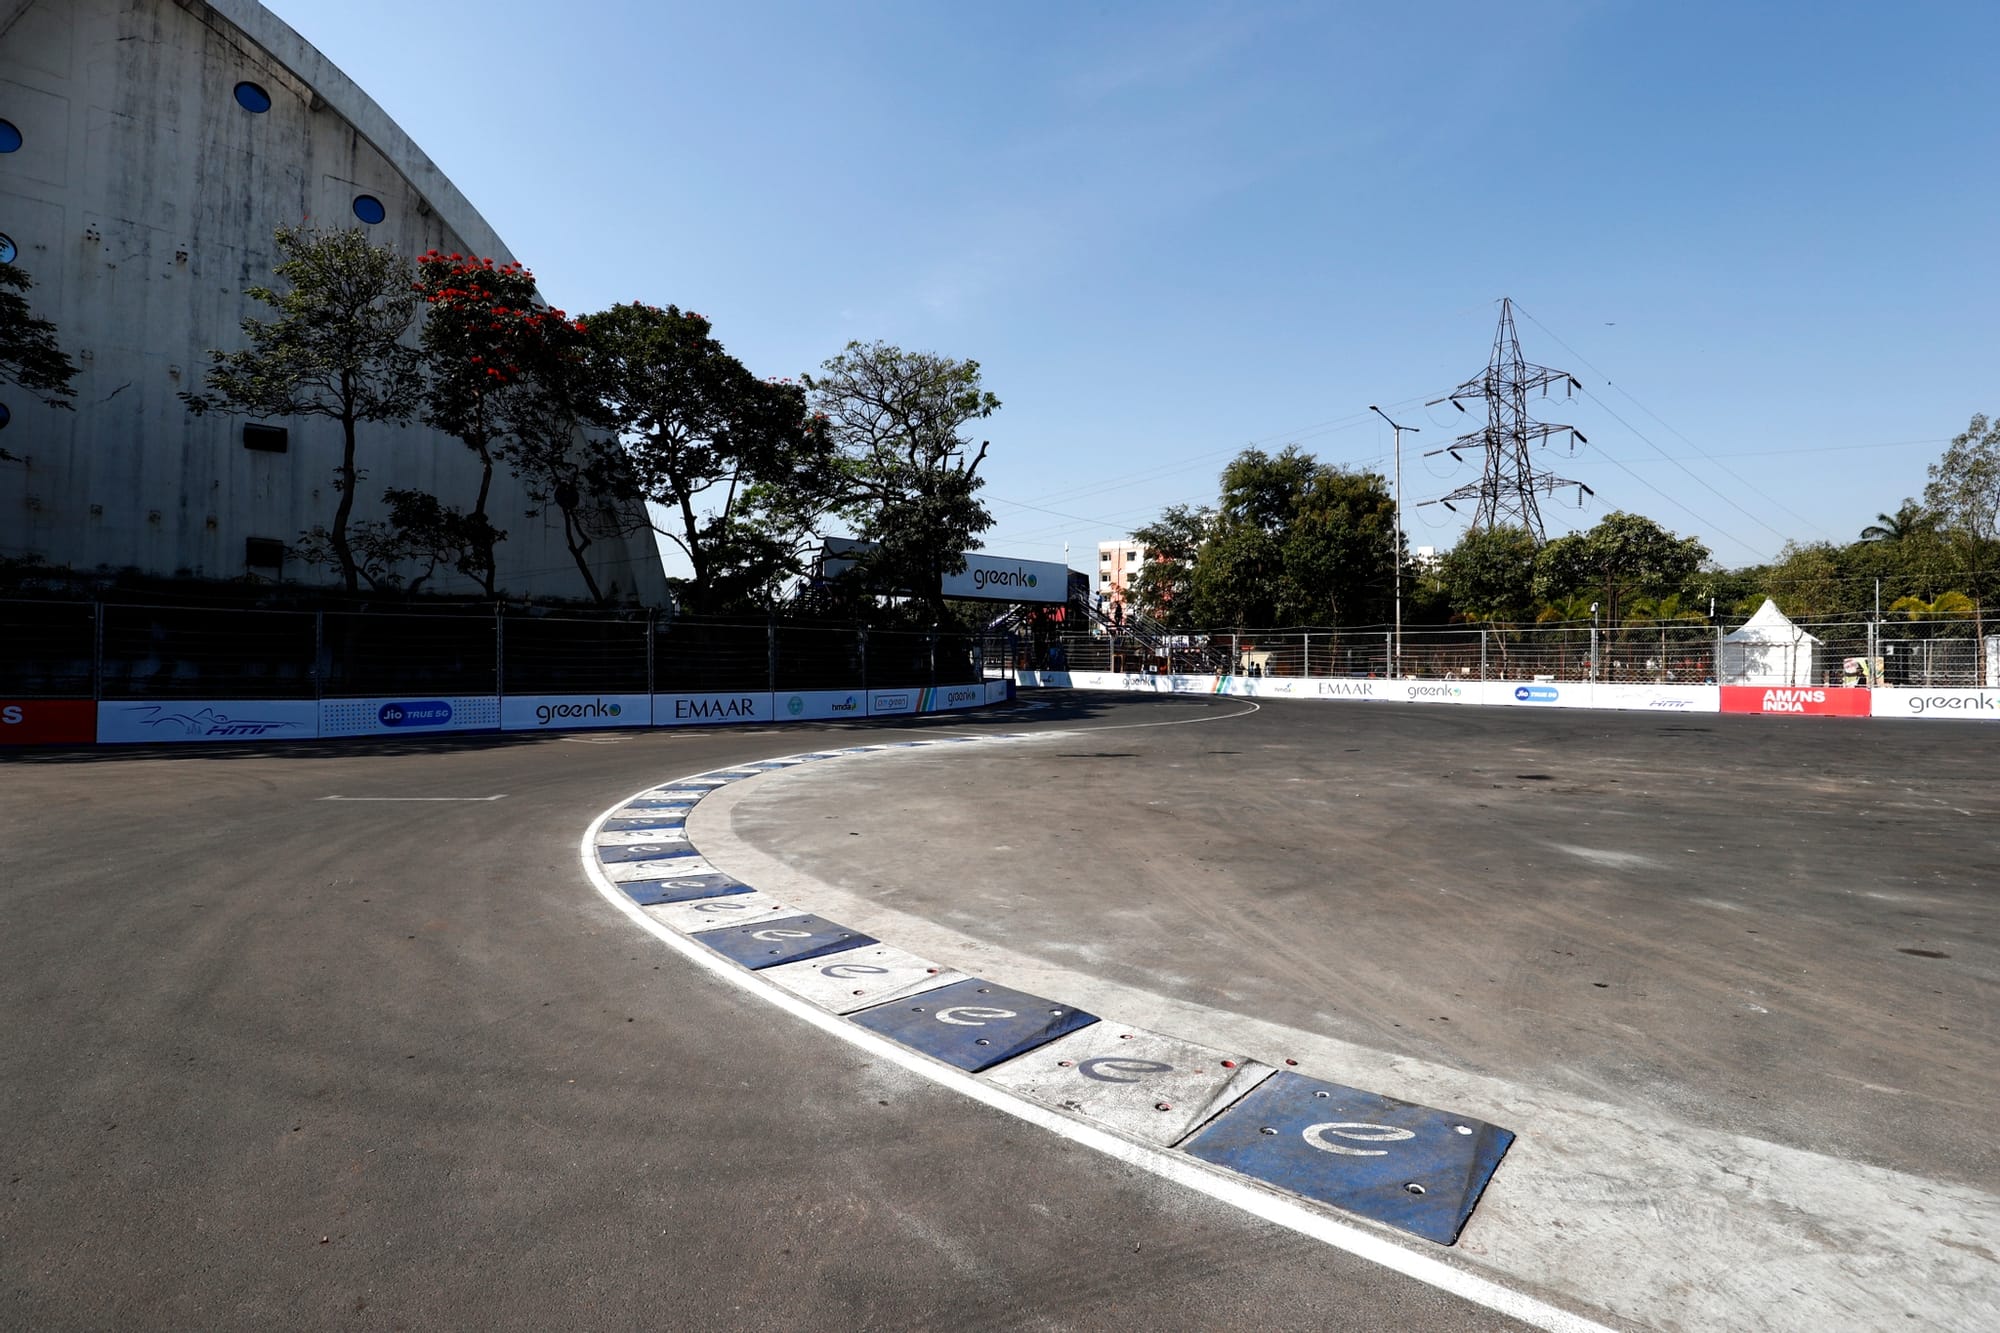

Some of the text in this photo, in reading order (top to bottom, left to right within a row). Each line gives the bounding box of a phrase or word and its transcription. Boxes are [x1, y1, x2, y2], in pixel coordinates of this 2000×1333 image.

[974, 567, 1037, 590] greenko
[1319, 683, 1373, 695] EMAAR
[1408, 684, 1461, 699] greenko
[1763, 690, 1825, 703] AM/NS
[675, 699, 755, 719] EMAAR
[1763, 701, 1804, 712] INDIA
[1909, 692, 2000, 713] greenk
[383, 707, 449, 720] Jio TRUE 5G
[536, 698, 622, 725] greenko
